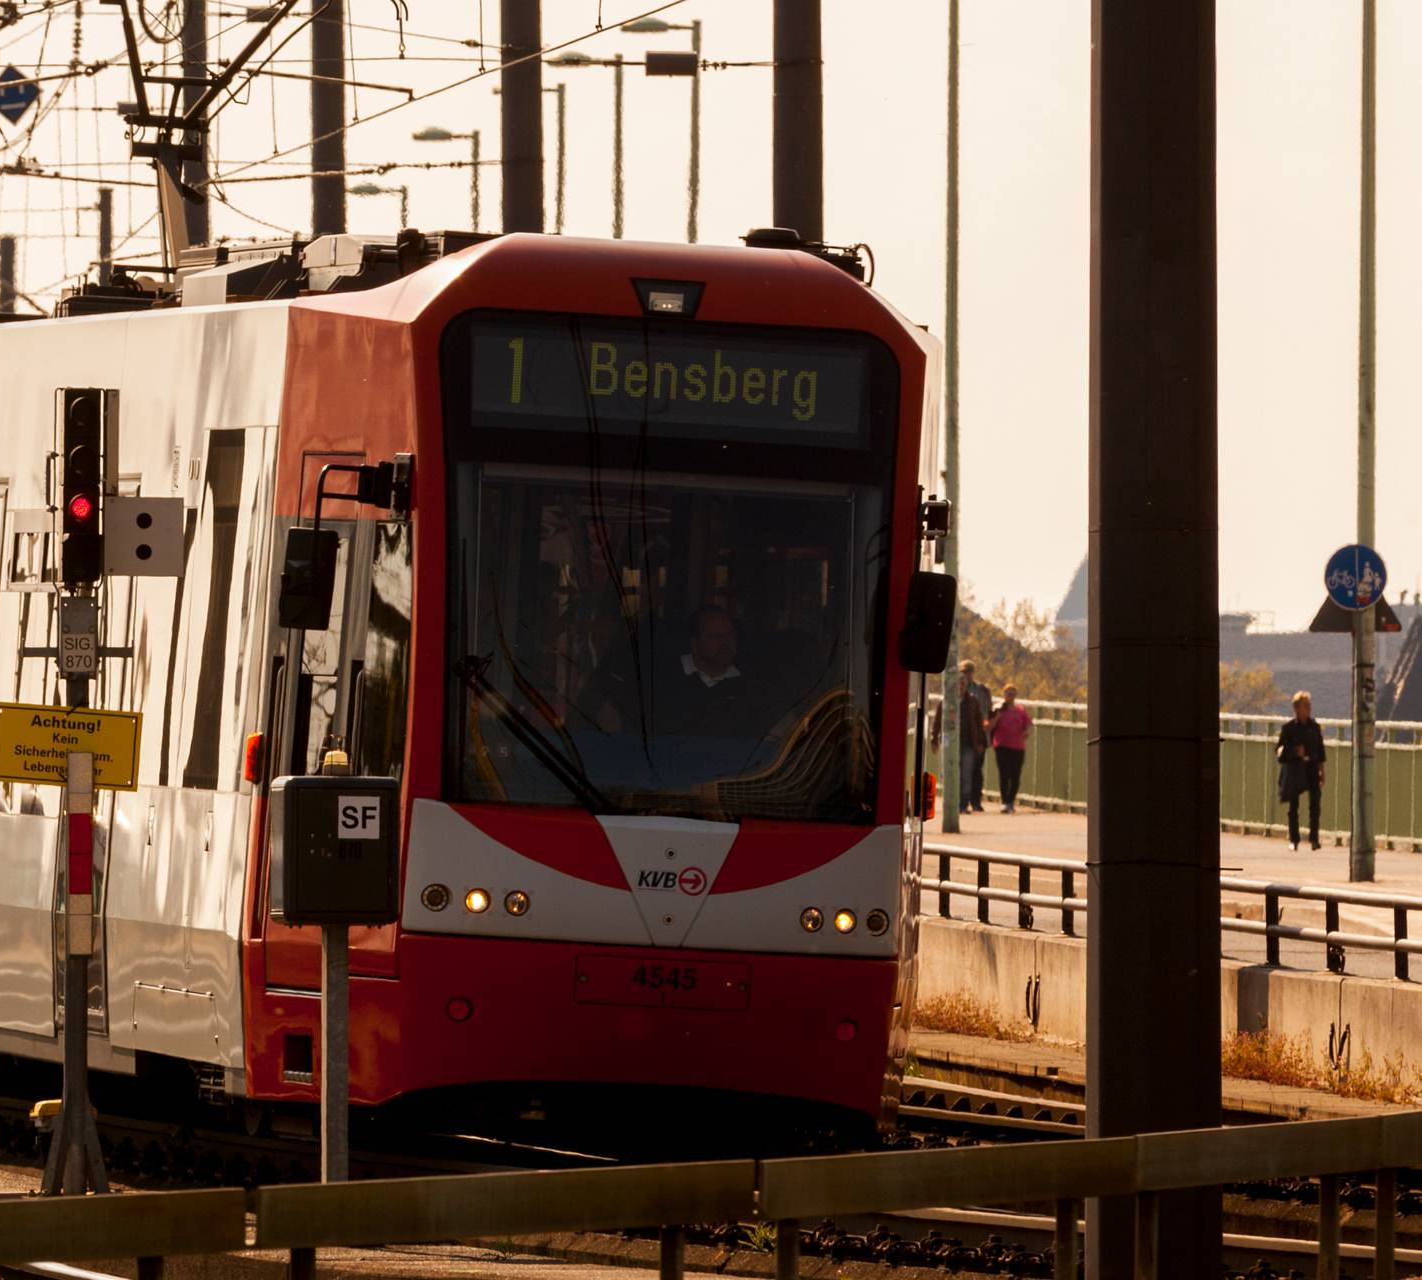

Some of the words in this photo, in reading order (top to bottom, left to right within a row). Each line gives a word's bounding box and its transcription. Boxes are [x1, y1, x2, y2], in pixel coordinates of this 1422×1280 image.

[509, 337, 524, 404] 1
[589, 342, 818, 421] Bensberg
[65, 637, 94, 650] SIG.
[66, 655, 92, 668] 870
[30, 715, 102, 734] Achtung!
[52, 733, 78, 745] Kein
[342, 806, 377, 829] SF
[638, 870, 678, 889] KVB
[632, 964, 698, 991] 4545
